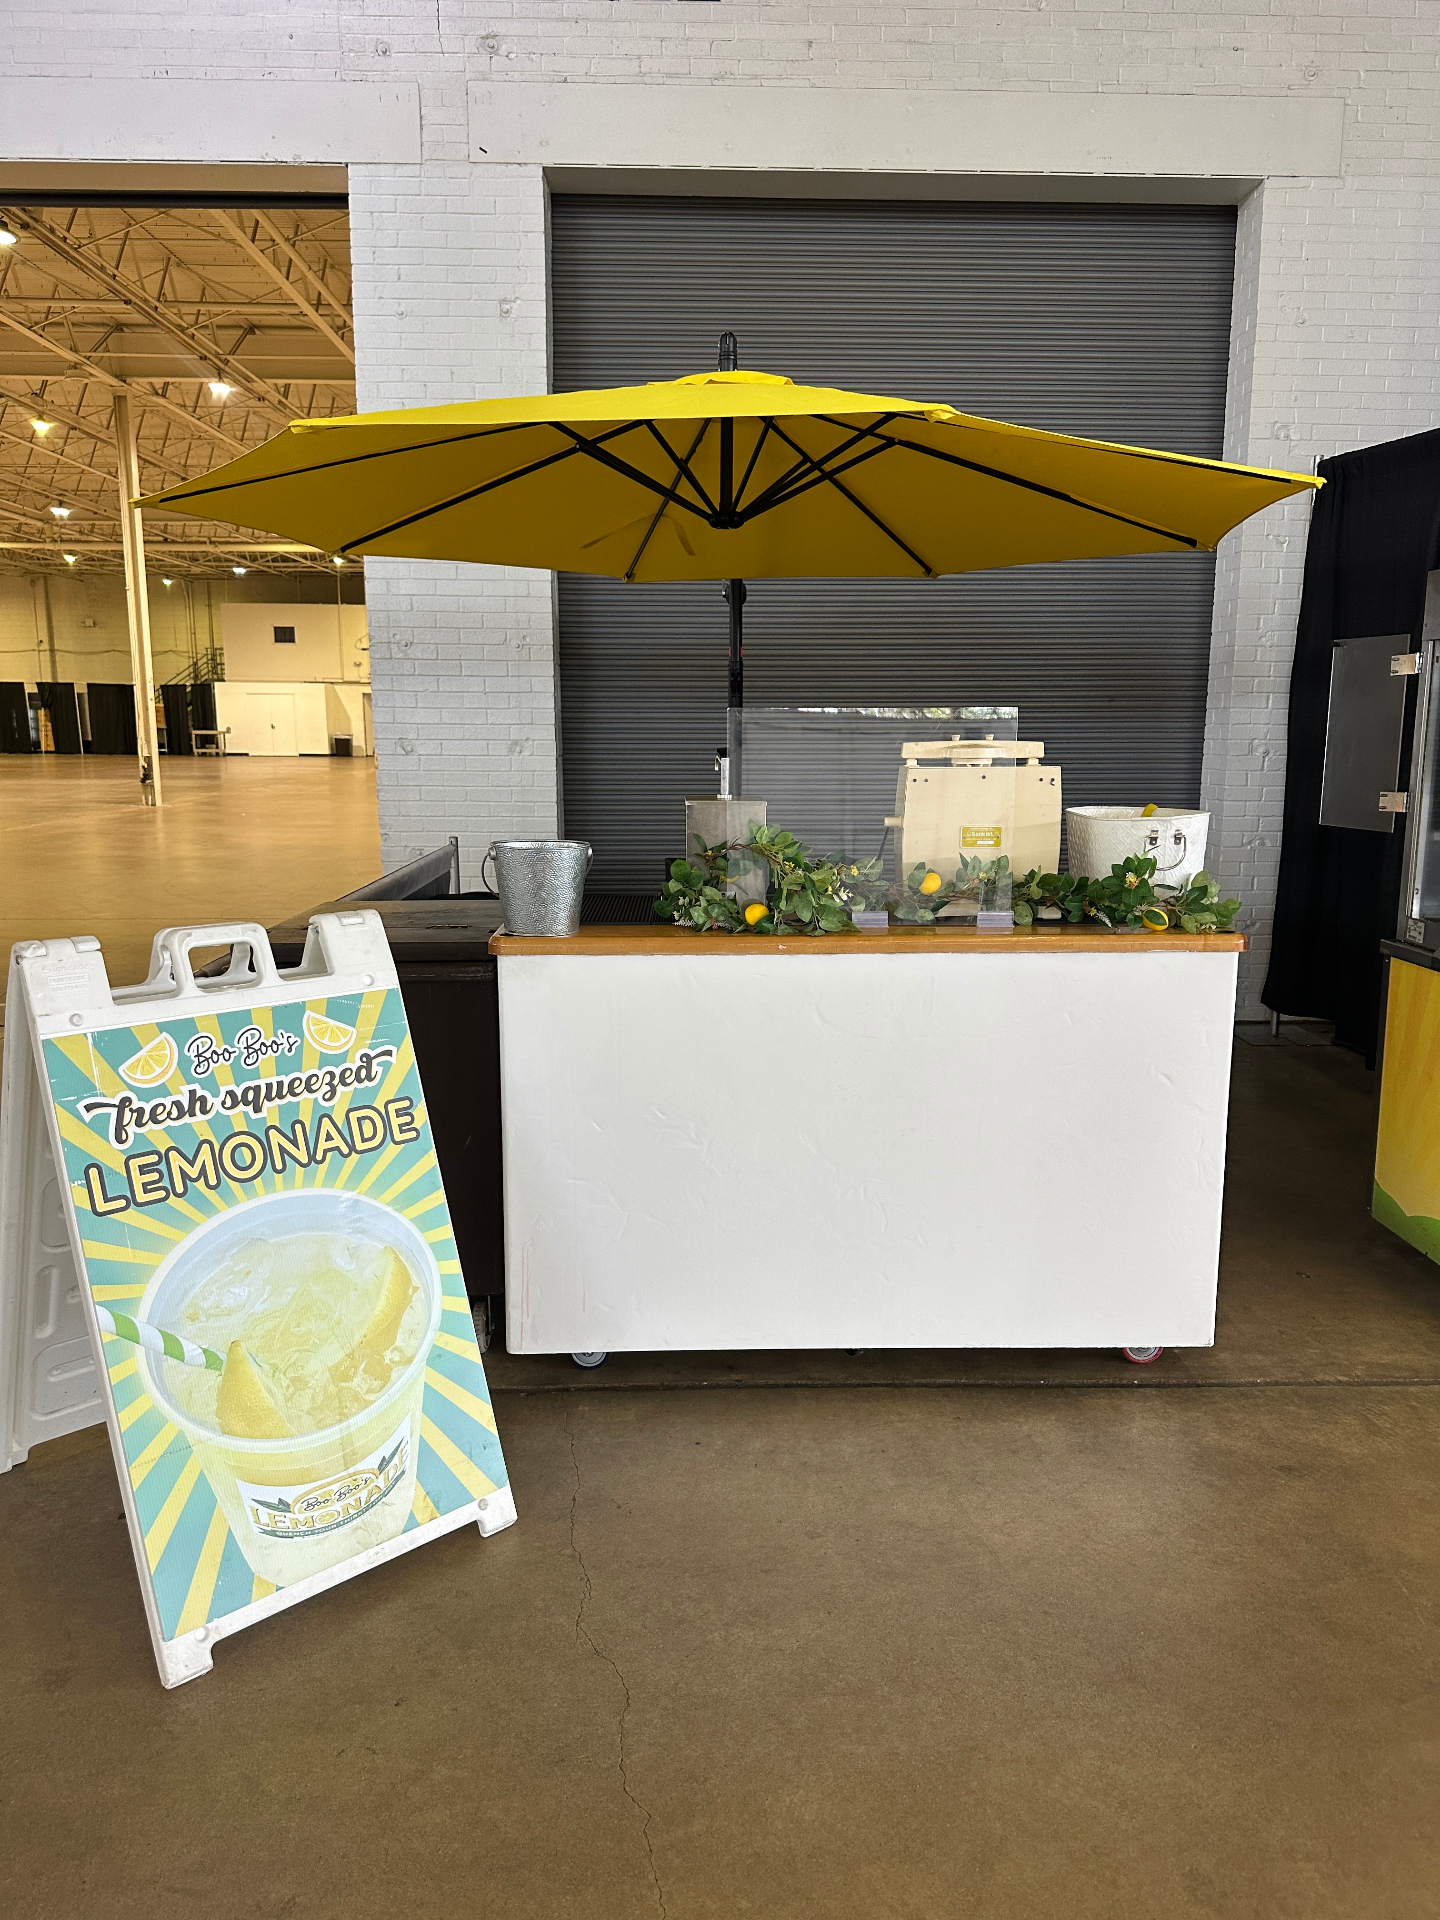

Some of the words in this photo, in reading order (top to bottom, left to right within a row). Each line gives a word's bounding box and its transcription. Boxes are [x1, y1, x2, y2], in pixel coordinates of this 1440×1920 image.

[84, 1088, 215, 1144] fresh
[221, 1049, 394, 1115] squeezed
[188, 1035, 237, 1076] Boo
[236, 1027, 299, 1067] Boo's
[84, 1095, 420, 1217] LEMONADE
[249, 1439, 410, 1530] LEMONADE
[301, 1496, 333, 1511] Boo
[333, 1476, 372, 1502] Boo's
